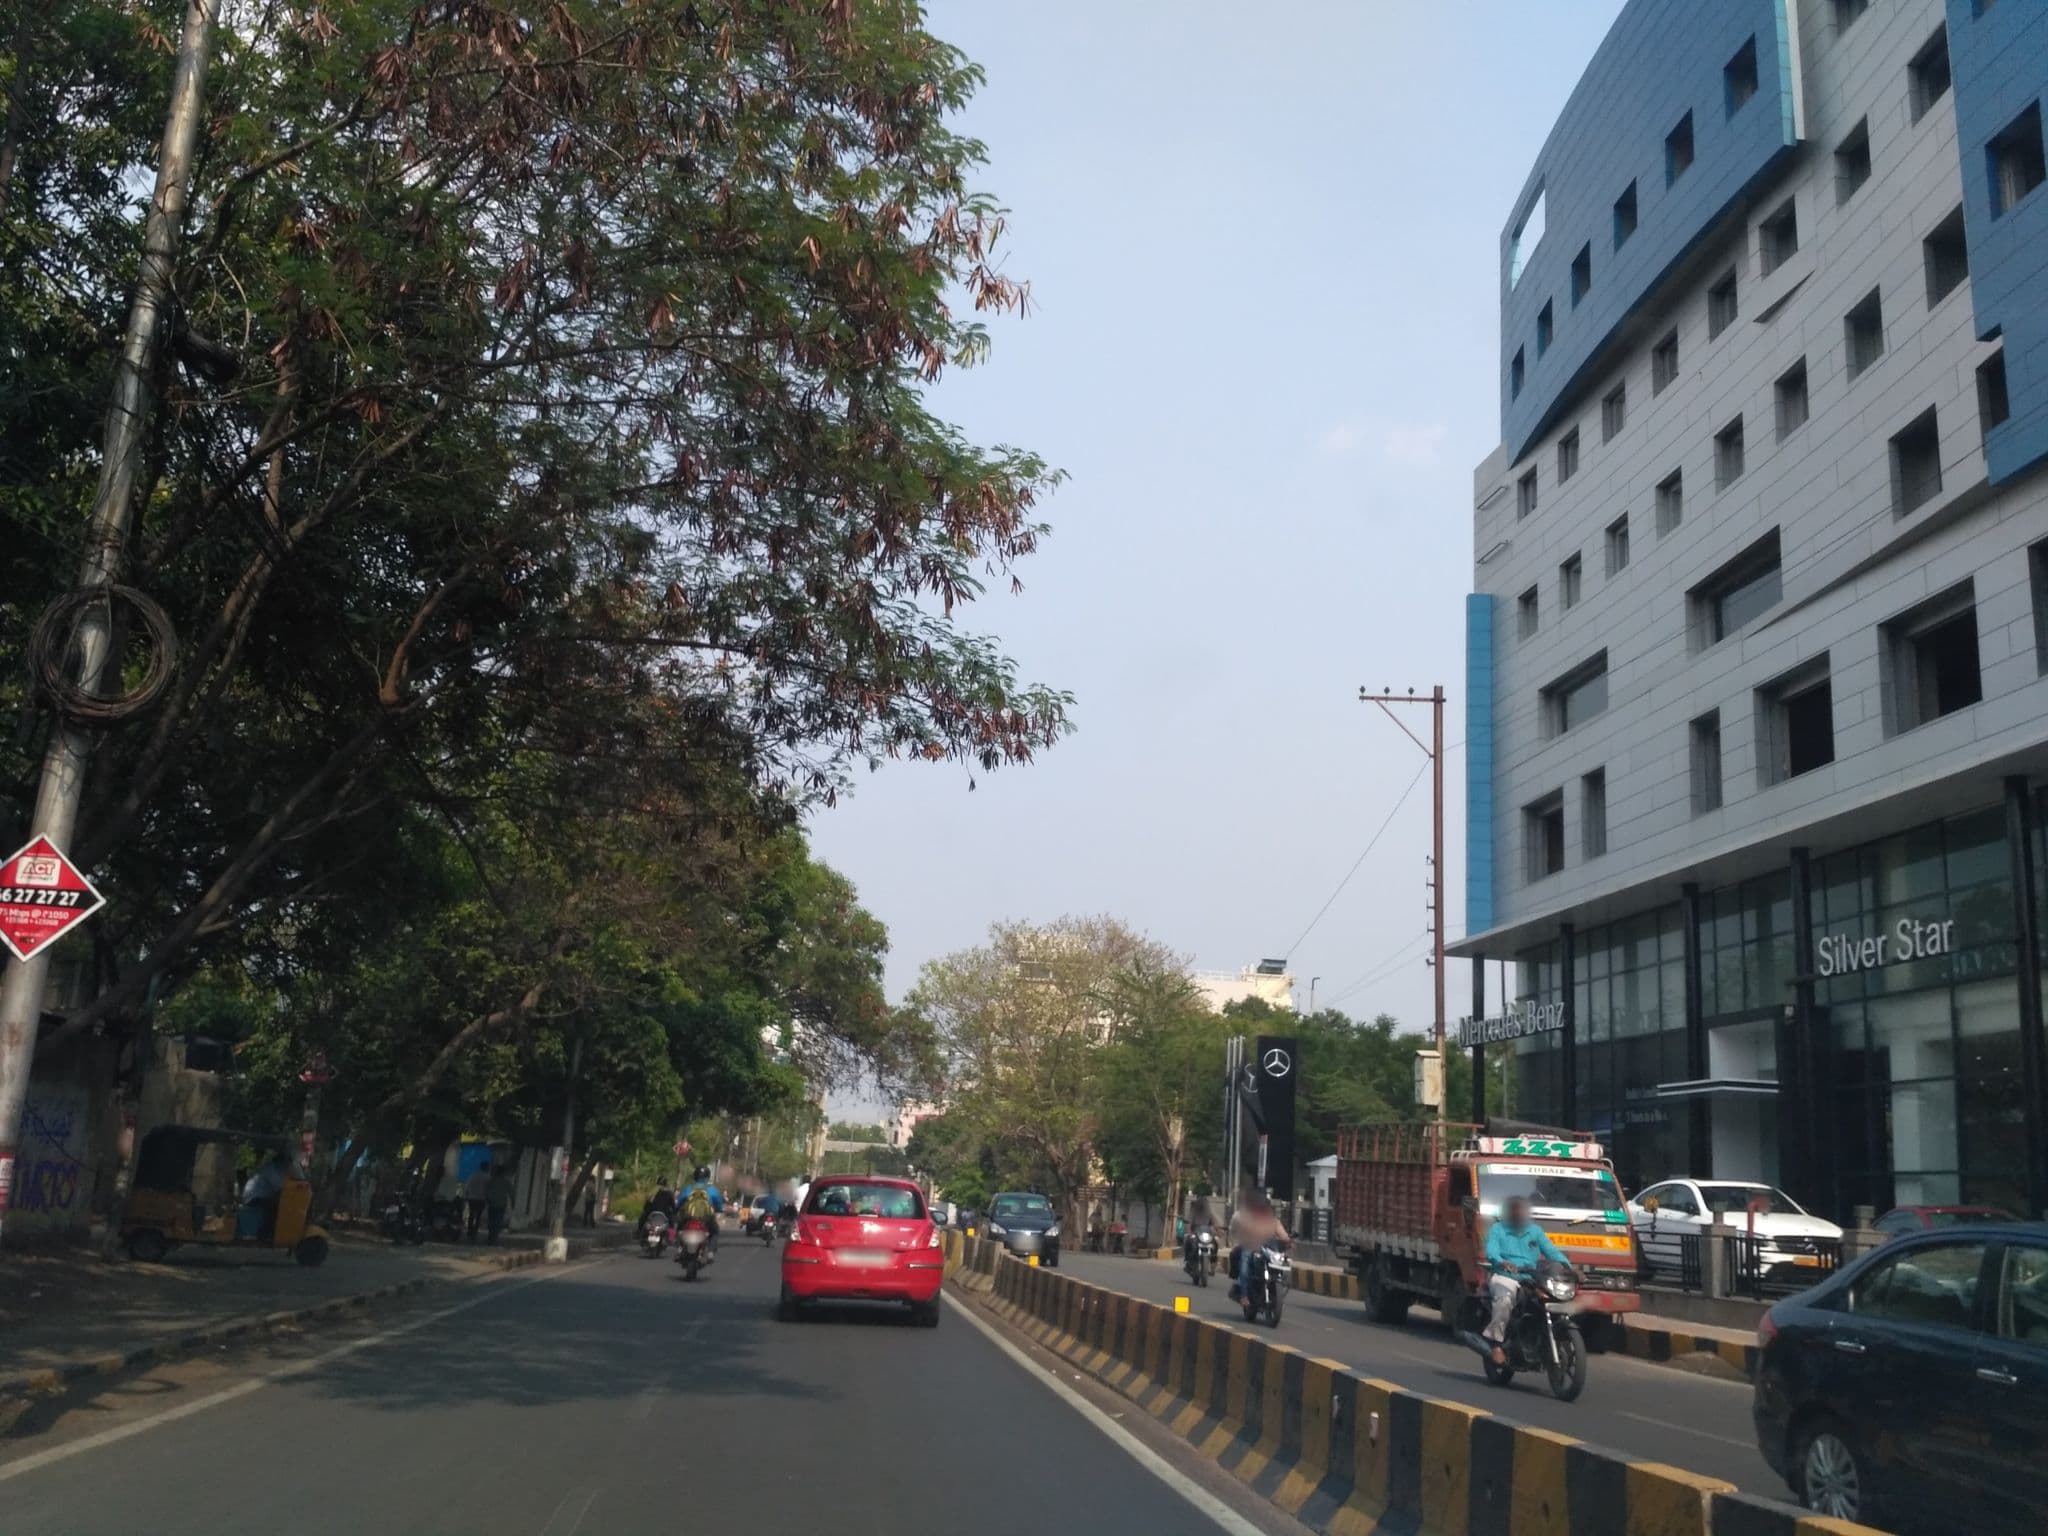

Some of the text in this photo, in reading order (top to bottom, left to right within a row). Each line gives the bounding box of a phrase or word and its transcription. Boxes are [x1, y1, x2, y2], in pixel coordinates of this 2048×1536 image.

[23, 862, 55, 875] ACT
[15, 889, 34, 903] 27
[36, 891, 57, 905] 27
[58, 892, 79, 906] 27
[1819, 918, 1953, 976] Silver Star
